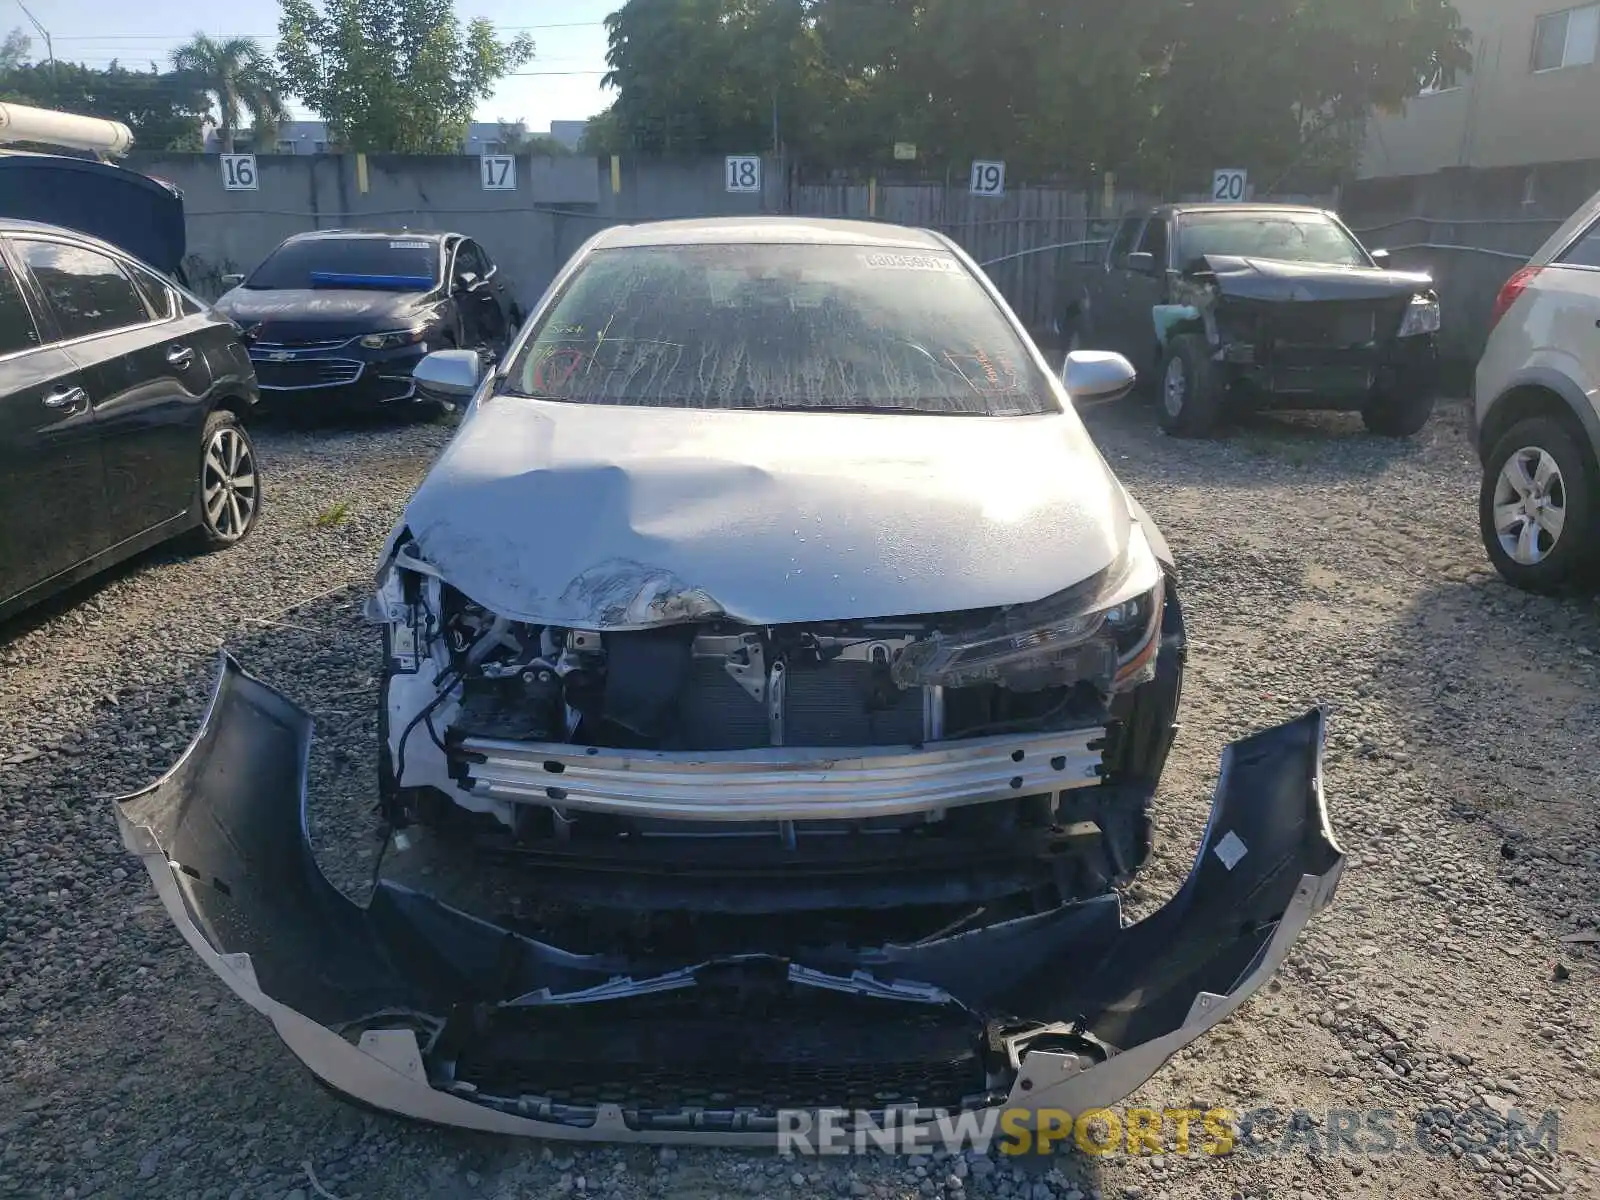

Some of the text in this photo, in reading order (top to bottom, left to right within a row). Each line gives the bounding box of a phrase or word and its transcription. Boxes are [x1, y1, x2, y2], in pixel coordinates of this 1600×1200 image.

[225, 158, 253, 185] 16
[485, 159, 510, 185] 17
[730, 160, 756, 187] 18
[975, 165, 1000, 191] 19
[1216, 174, 1242, 199] 20
